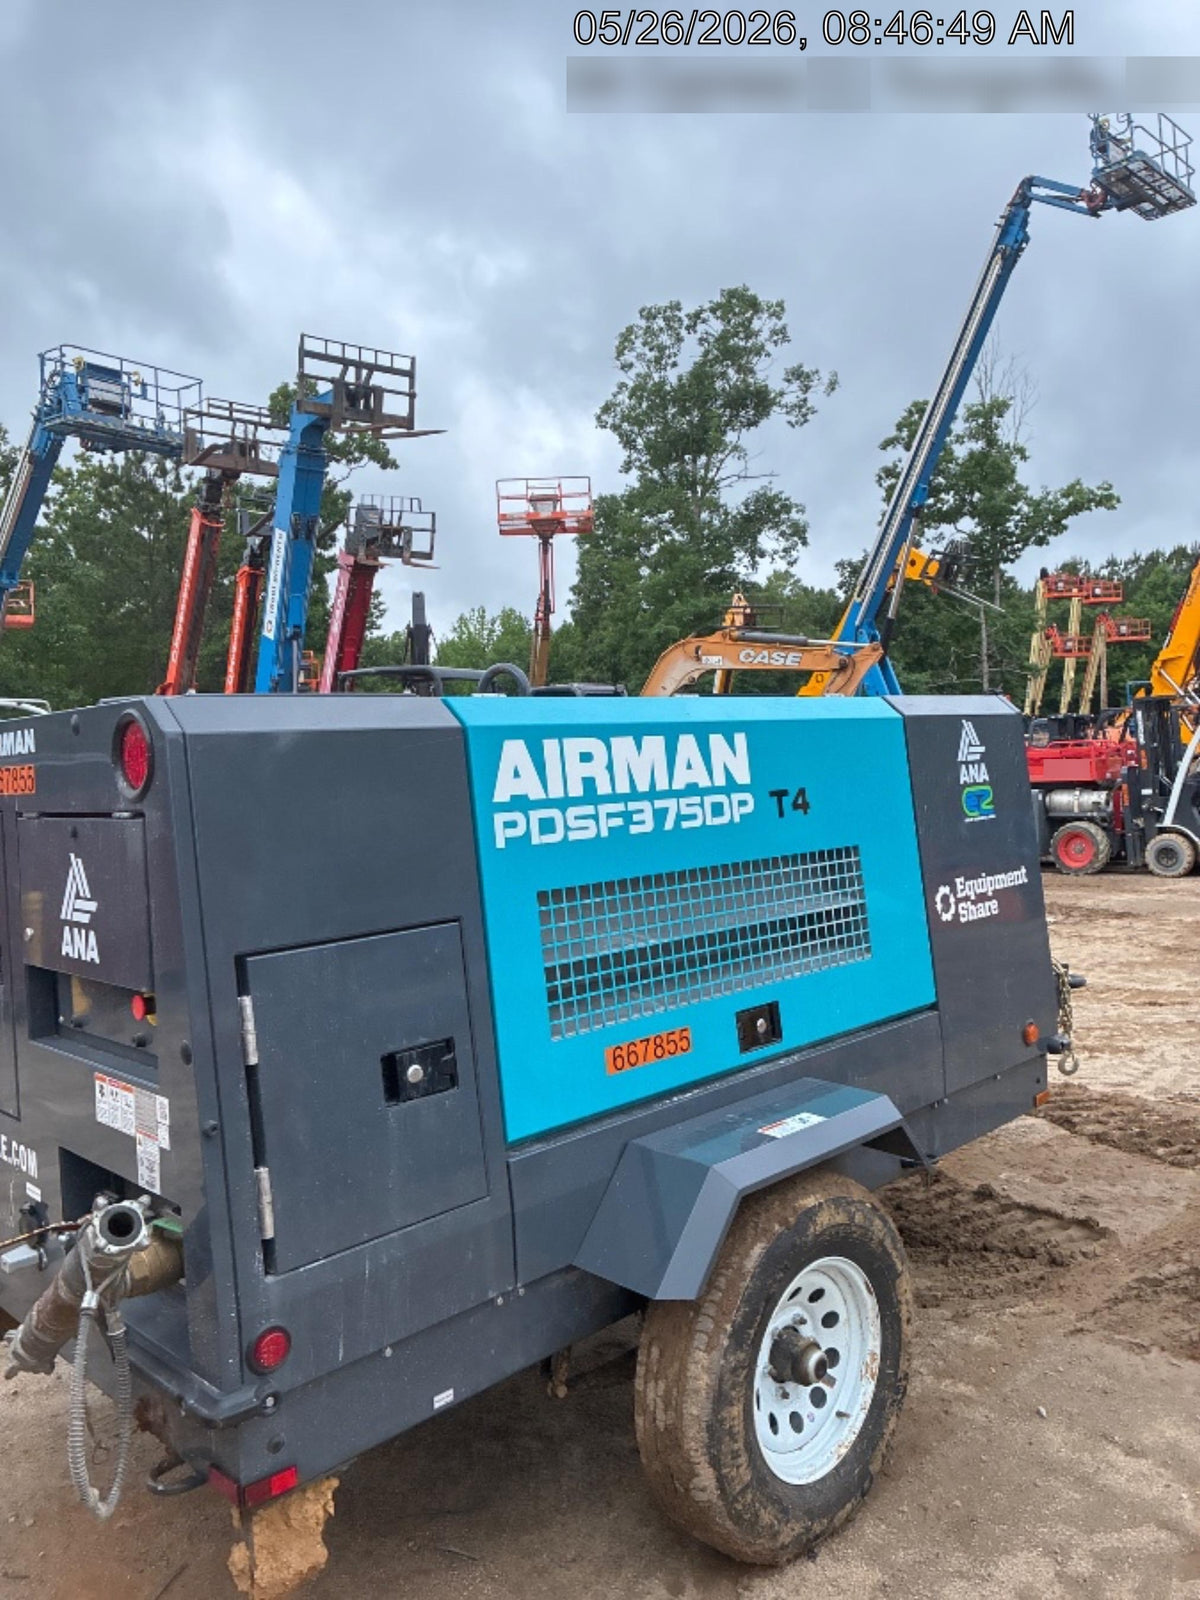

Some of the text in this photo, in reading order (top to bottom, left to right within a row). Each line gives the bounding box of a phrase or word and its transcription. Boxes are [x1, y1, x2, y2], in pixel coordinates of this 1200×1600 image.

[739, 649, 802, 666] CASE
[0, 728, 36, 756] MAN
[492, 732, 751, 802] AIRMAN
[959, 762, 990, 785] ANA
[768, 787, 811, 818] T4
[494, 792, 755, 849] PDSF375DP
[955, 865, 1029, 899] Equipment
[958, 899, 999, 923] Share
[61, 926, 100, 964] ANA
[612, 1028, 691, 1072] 667855
[0, 1134, 38, 1179] E.COM
